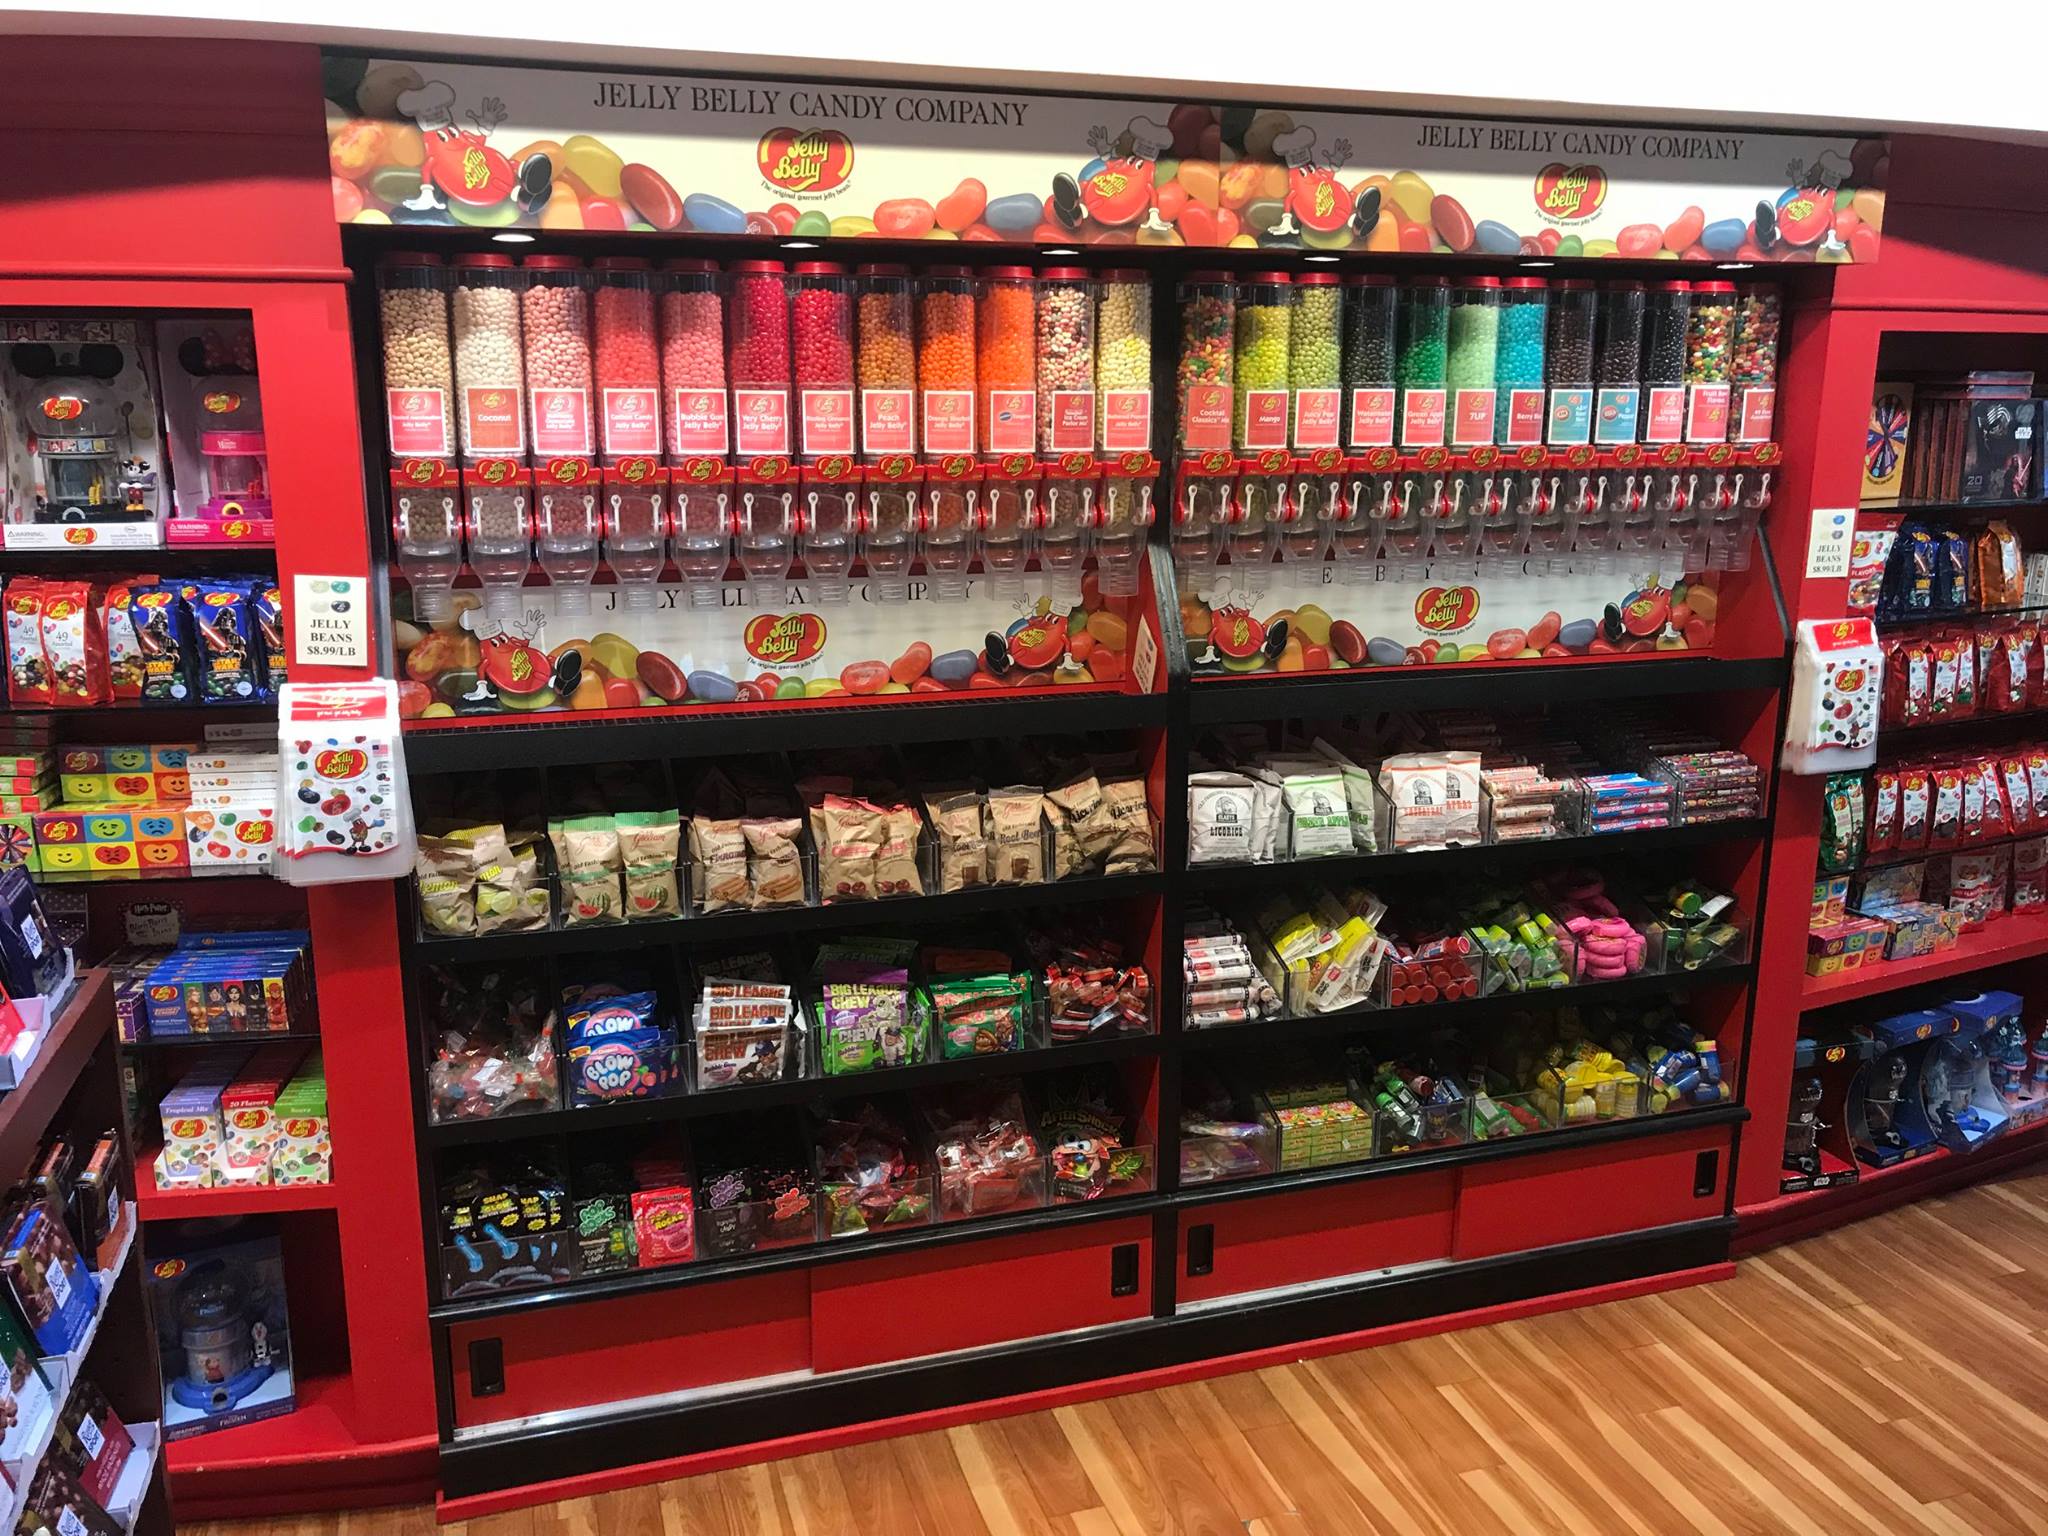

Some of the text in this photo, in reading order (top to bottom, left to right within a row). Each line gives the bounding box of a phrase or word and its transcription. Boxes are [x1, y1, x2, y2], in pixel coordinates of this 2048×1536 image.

[593, 82, 1029, 127] JELLY BELLY CANDY COMPANY
[787, 131, 830, 163] Jelly
[1417, 124, 1744, 160] JELLY BELLY CANDY COMPANY
[772, 156, 821, 188] Belly
[1557, 168, 1589, 193] Jelly
[1544, 187, 1581, 216] Belly
[478, 414, 511, 422] Coconut
[681, 412, 706, 420] Bubble
[743, 413, 782, 422] Very Cherry
[878, 412, 899, 420] Peach
[1409, 410, 1426, 418] Green
[1470, 412, 1486, 420] 7UP
[1517, 413, 1533, 421] Berry
[684, 420, 703, 430] Jelly
[870, 420, 887, 430] Jelly
[1259, 416, 1280, 424] Mango
[744, 421, 758, 431] Jelly
[1967, 475, 1983, 486] 20
[1817, 544, 1841, 553] JELLY
[1815, 555, 1841, 563] BEANS
[1852, 565, 1877, 576] FLAVORS
[1435, 588, 1463, 609] Jelly
[1424, 607, 1457, 631] Belly
[23, 625, 35, 635] 49
[310, 619, 351, 631] JELLY
[770, 614, 806, 639] Jelly
[55, 631, 69, 642] 49
[310, 632, 352, 643] BEANS
[306, 645, 356, 656] $8.99/LB
[757, 636, 799, 663] Belly
[331, 749, 353, 764] Jelly
[323, 763, 350, 779] Belly
[248, 820, 266, 832] Jelly
[1210, 826, 1243, 837] LICORICE
[243, 830, 263, 843] Belly
[1000, 832, 1019, 845] Root
[832, 984, 851, 995] BIG
[831, 996, 869, 1010] CHEW
[709, 1004, 786, 1020] BIG LEAGUE
[838, 1027, 879, 1044] CHEW
[705, 1041, 747, 1061] CHEW
[587, 1055, 635, 1081] BLOW
[599, 1070, 632, 1091] POP
[241, 1099, 269, 1107] Flavors
[165, 1105, 194, 1114] Tropical
